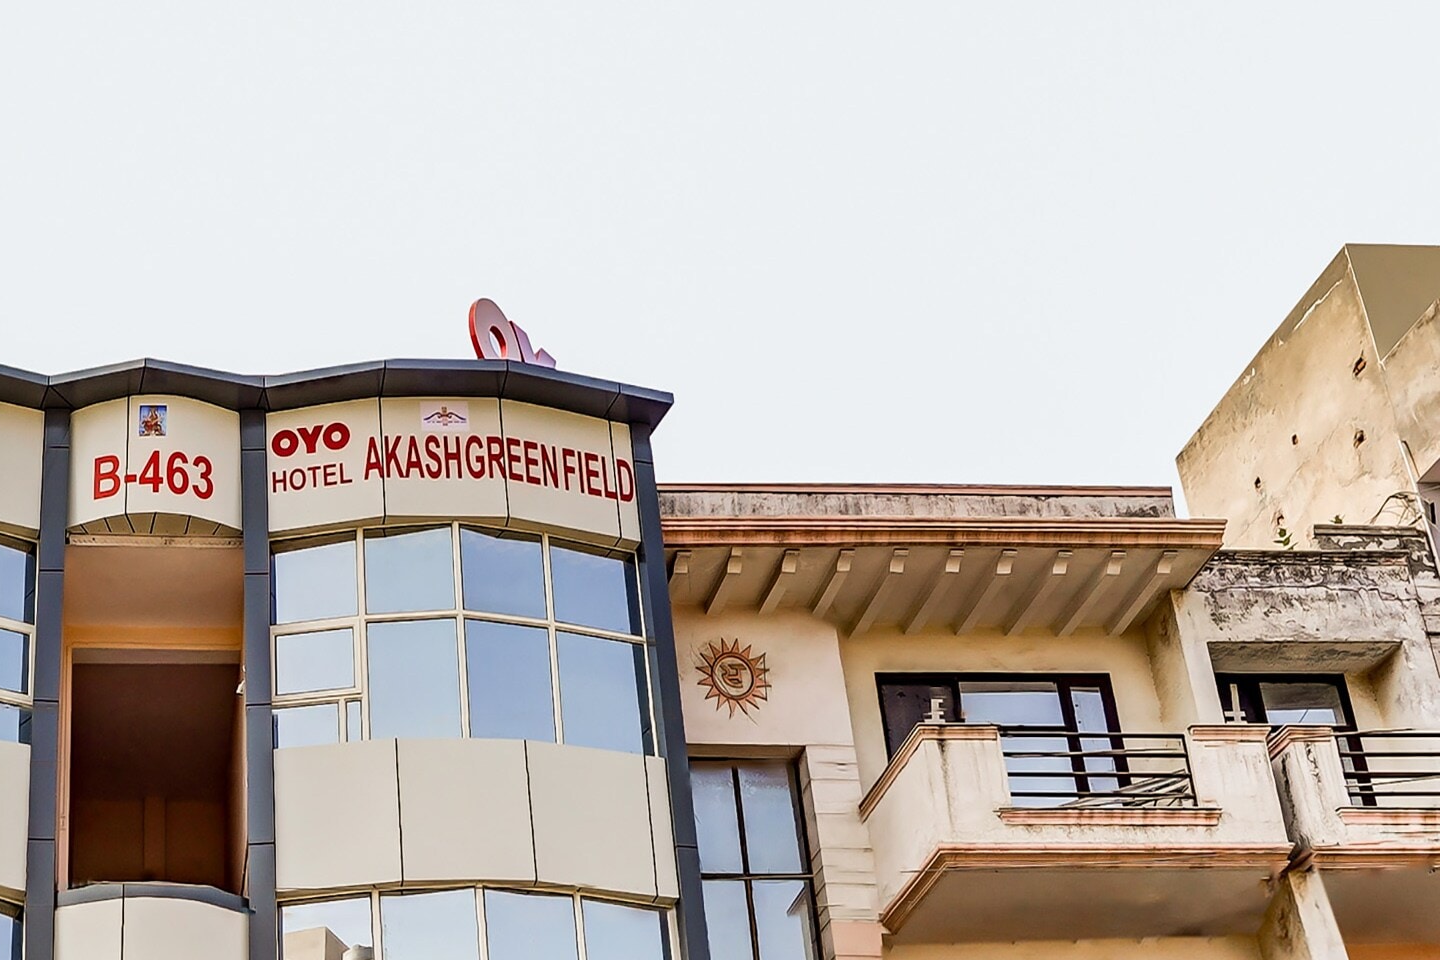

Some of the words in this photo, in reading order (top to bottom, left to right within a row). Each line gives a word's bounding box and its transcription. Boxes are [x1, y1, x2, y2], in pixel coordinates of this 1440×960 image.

[271, 422, 350, 457] OYO
[93, 450, 214, 500] B-463
[272, 463, 353, 493] HOTEL
